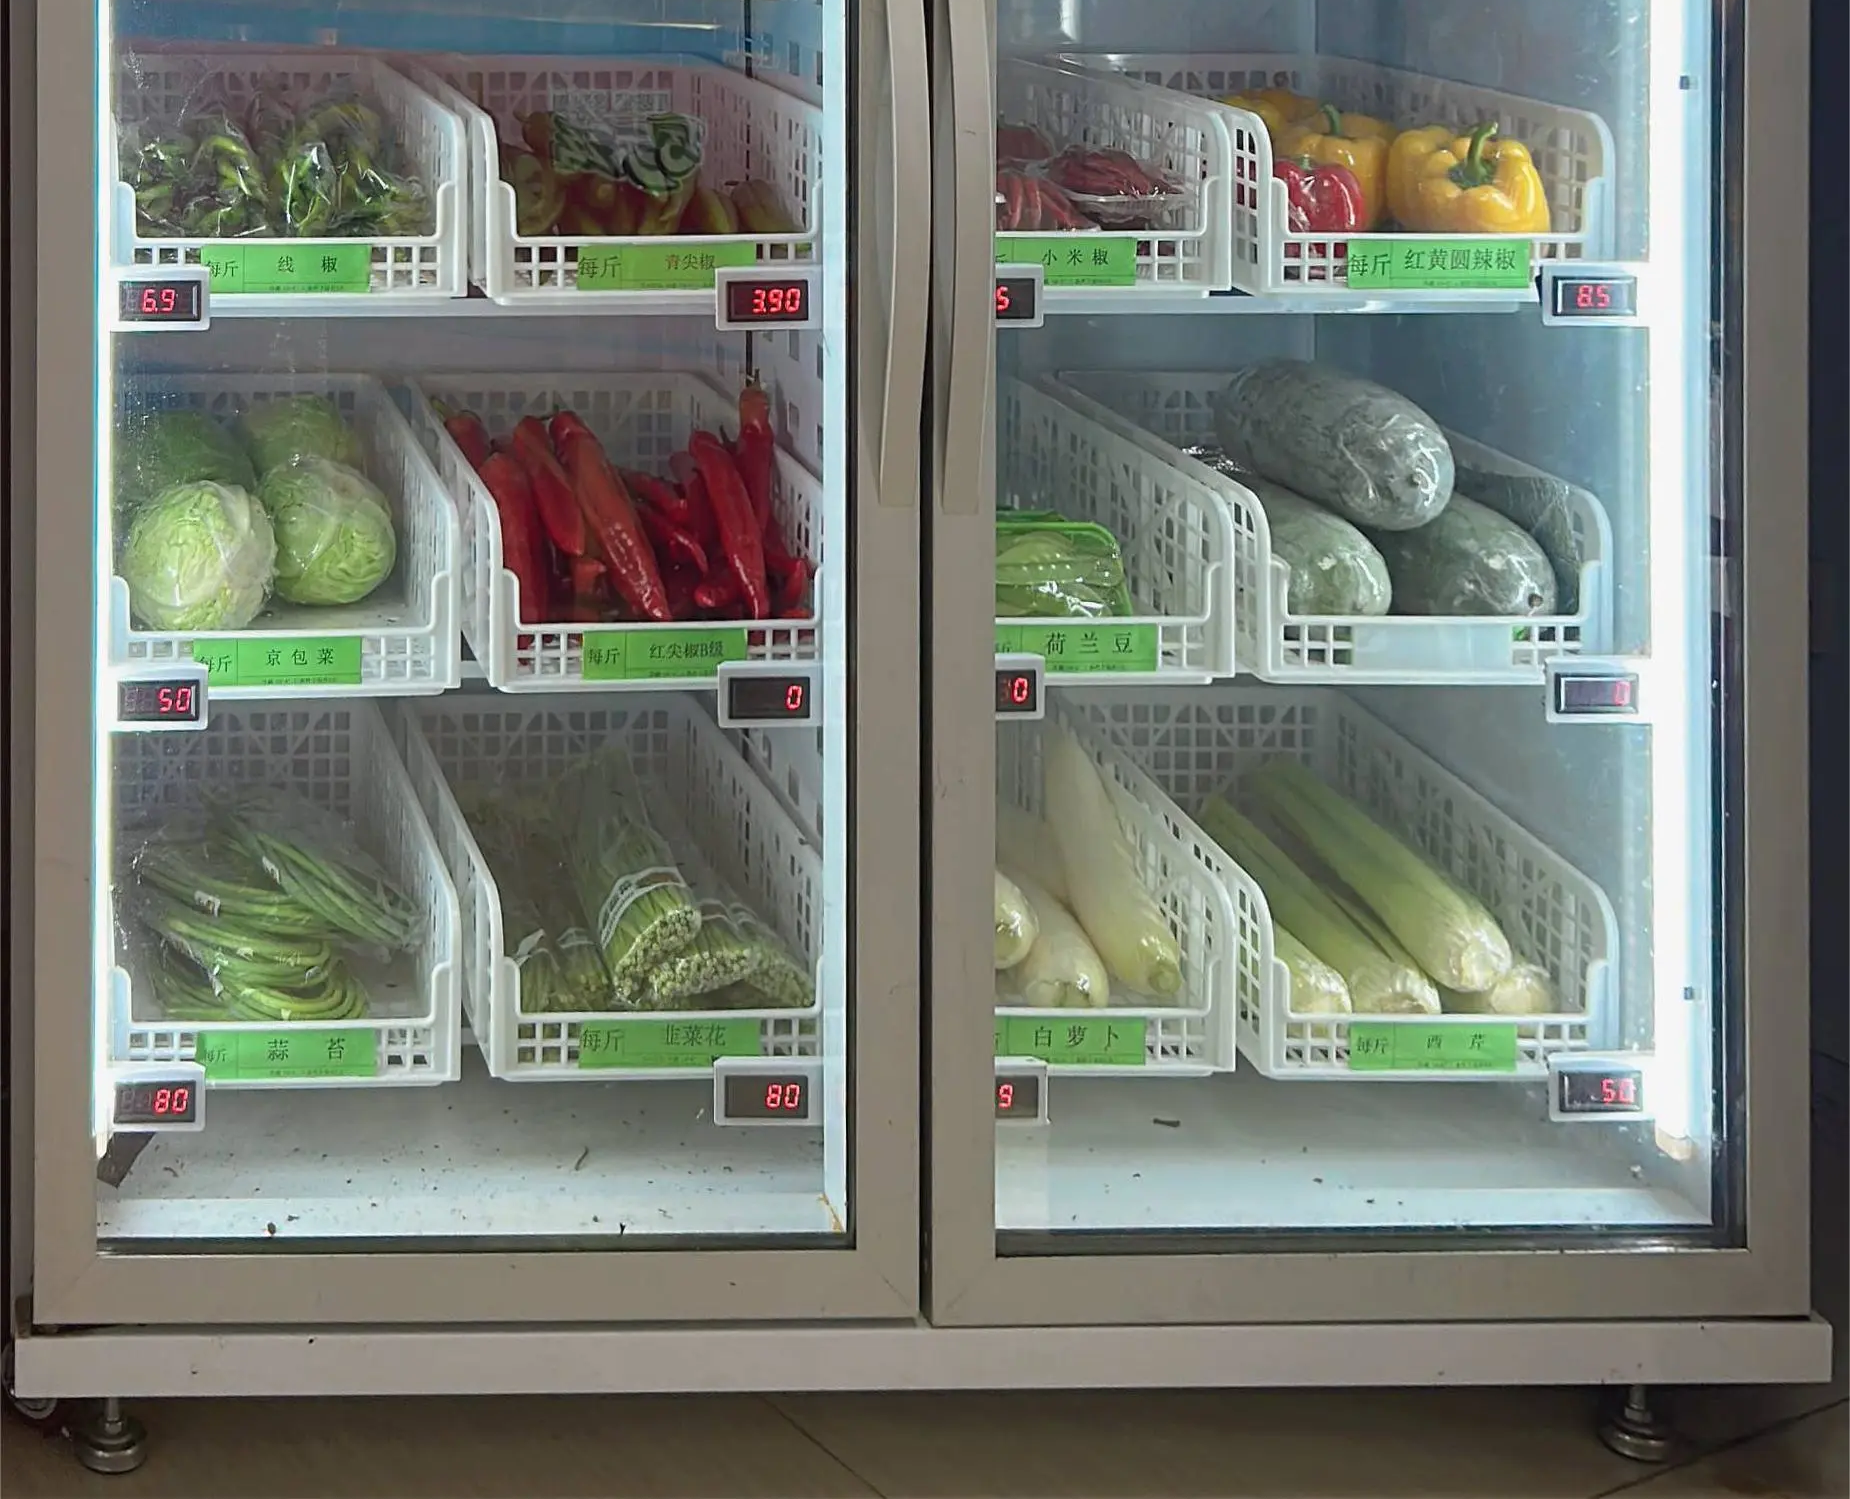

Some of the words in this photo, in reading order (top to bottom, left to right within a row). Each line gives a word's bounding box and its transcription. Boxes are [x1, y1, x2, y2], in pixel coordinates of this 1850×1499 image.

[278, 255, 339, 274] 线椒
[578, 255, 621, 279] 每斤
[1041, 248, 1110, 267] 小米椒
[1350, 253, 1392, 277] 每斤
[1404, 248, 1517, 272] 红黄圆辣椒
[1046, 631, 1133, 656] 荷兰豆
[265, 648, 336, 667] 京包菜
[587, 648, 621, 666] 每斤
[579, 1028, 625, 1052] 每斤
[663, 1024, 727, 1048] 韭菜花
[1034, 1025, 1119, 1051] 白萝卜
[1356, 1034, 1390, 1055] 每斤
